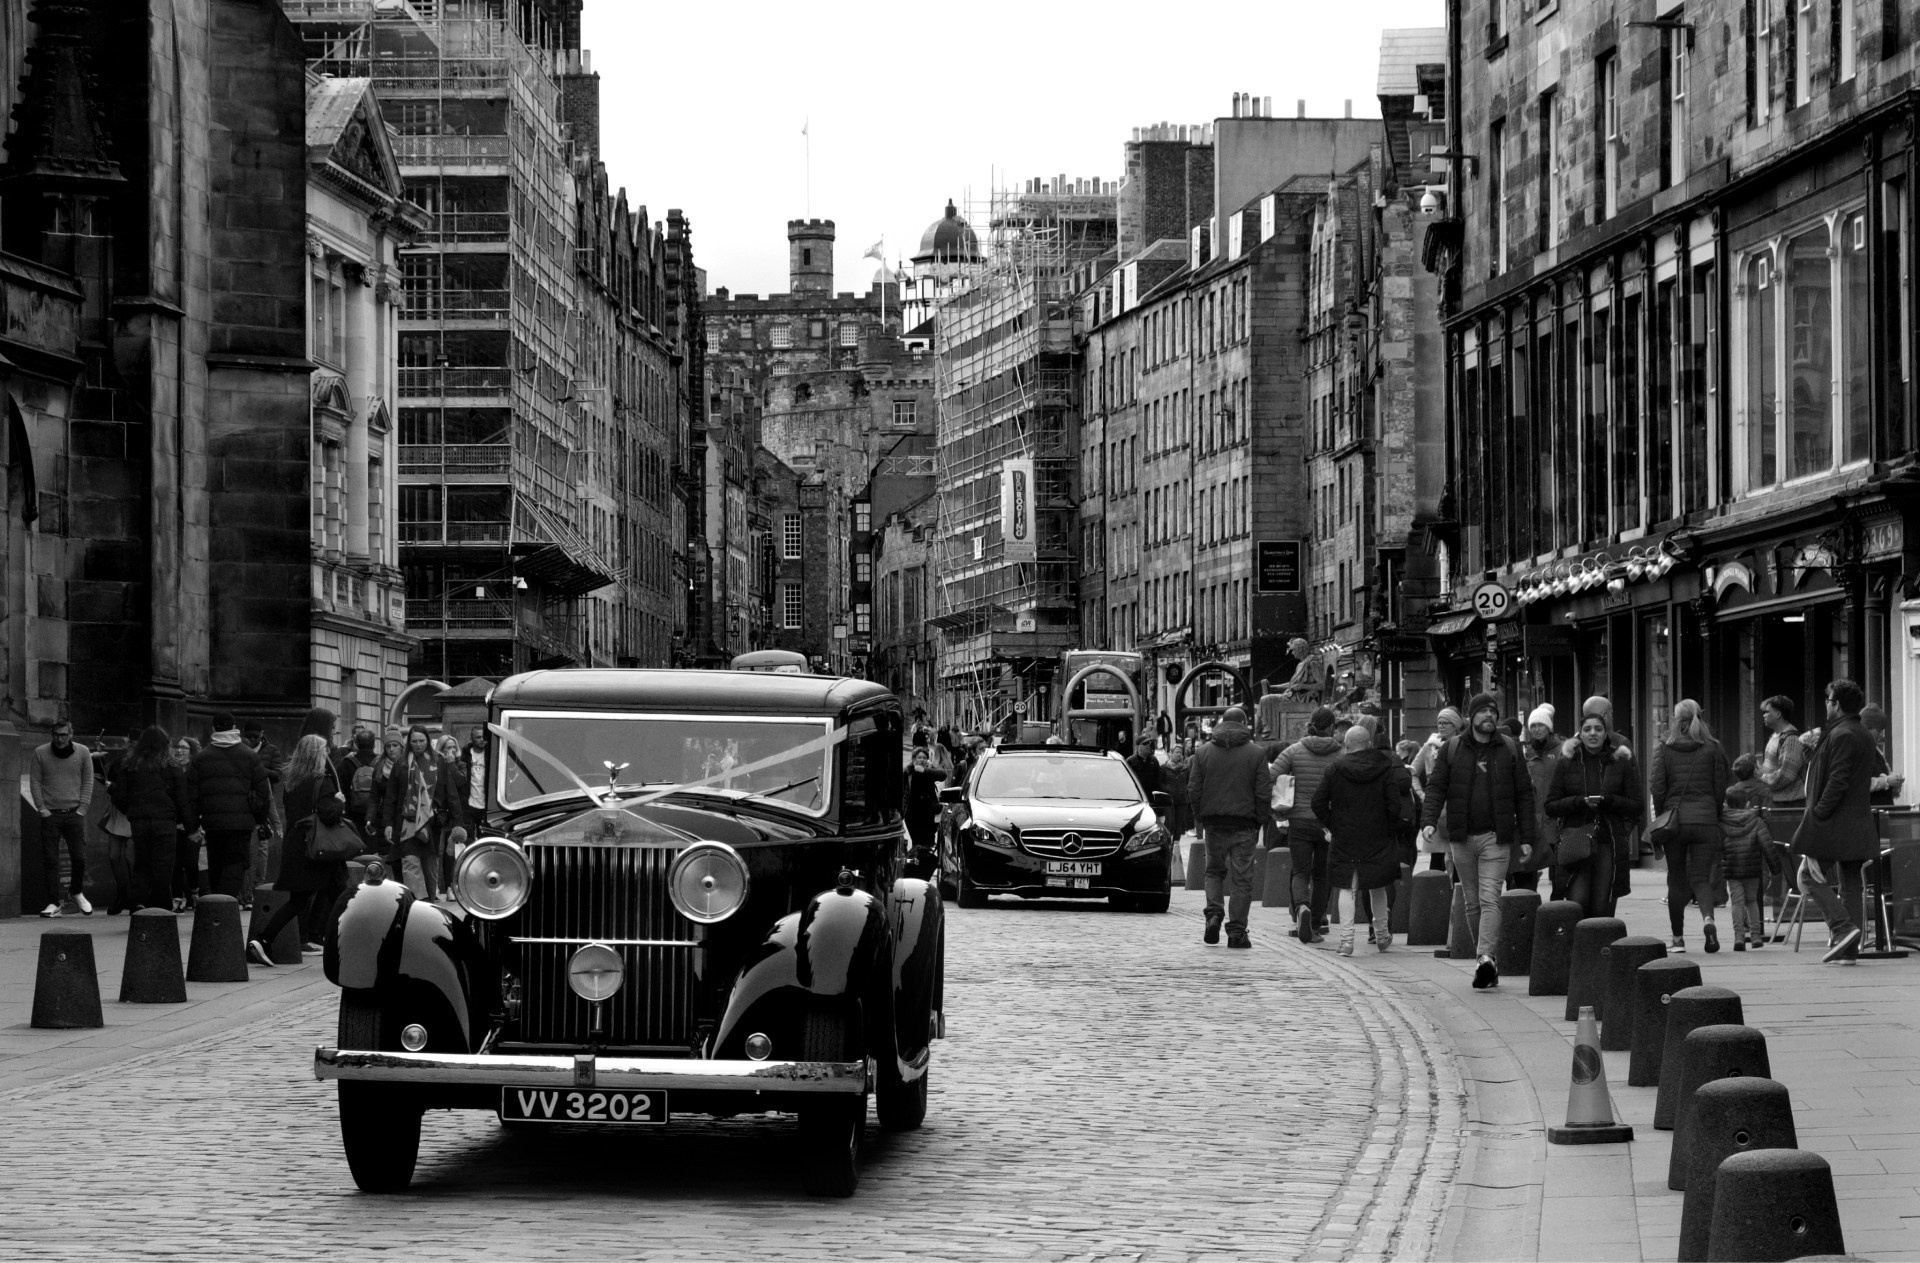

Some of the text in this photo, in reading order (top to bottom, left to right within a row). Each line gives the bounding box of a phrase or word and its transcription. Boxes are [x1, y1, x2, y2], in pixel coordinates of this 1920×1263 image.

[1015, 492, 1023, 537] ROOFING
[1871, 524, 1893, 551] 369
[1478, 593, 1505, 608] 20
[1048, 863, 1100, 873] LJ64 YHT
[517, 1090, 651, 1121] VV 3202
